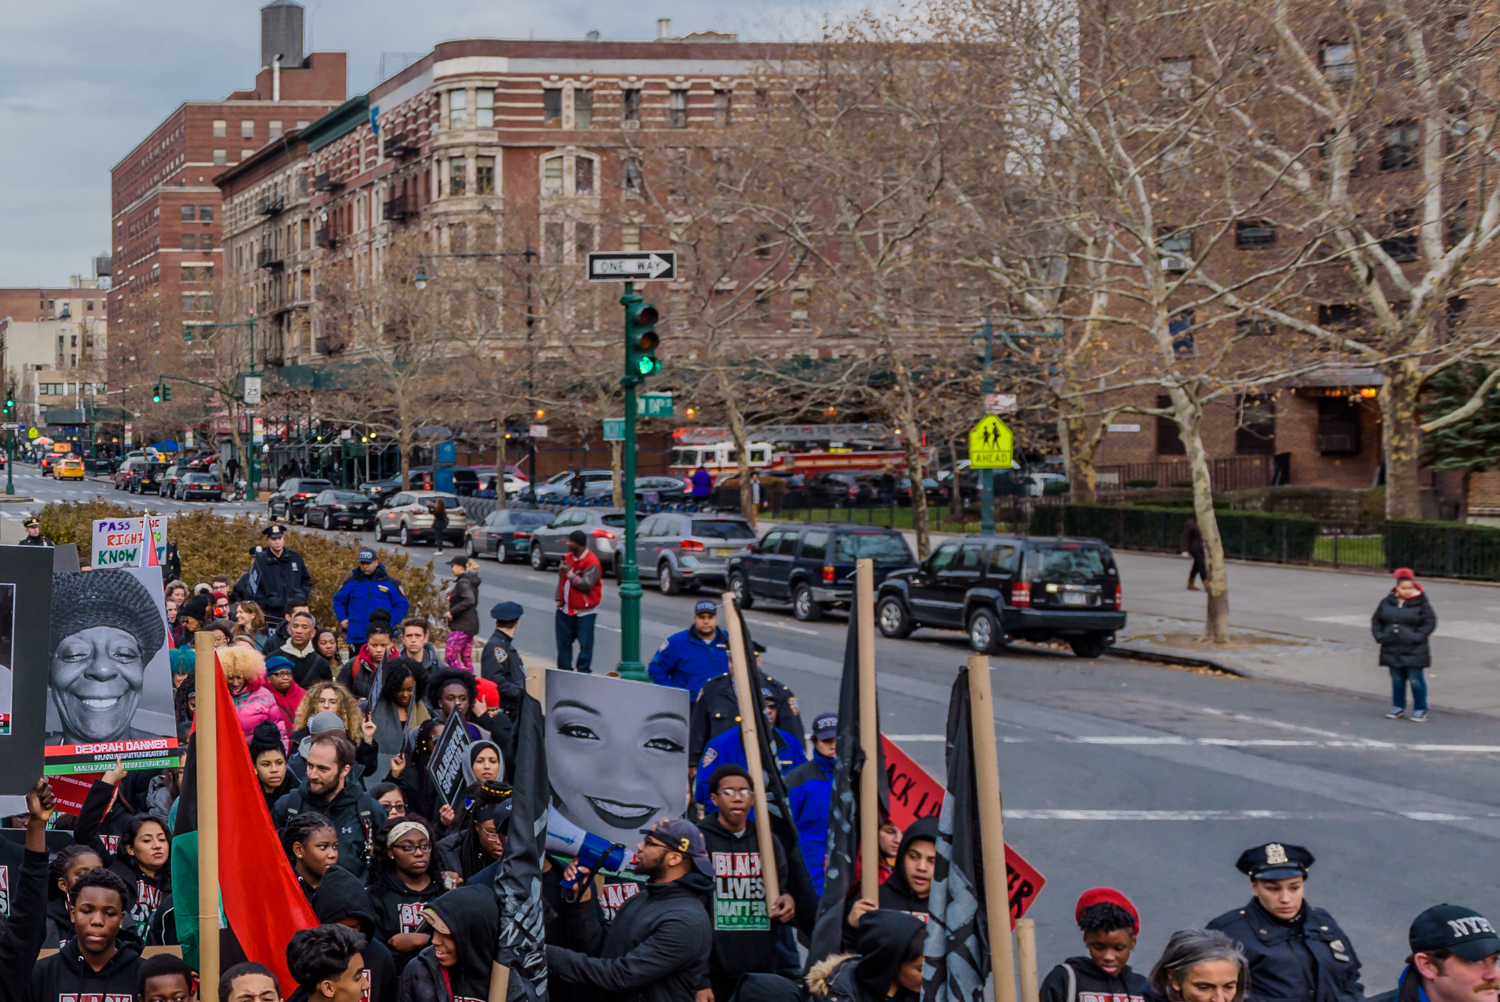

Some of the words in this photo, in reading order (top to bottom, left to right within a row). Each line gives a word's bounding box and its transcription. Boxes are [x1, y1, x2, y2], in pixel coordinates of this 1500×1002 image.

[600, 261, 625, 273] ONE
[636, 260, 662, 272] WAY
[247, 387, 259, 396] 25
[975, 453, 1008, 464] AHEAD
[98, 521, 132, 533] PASS
[97, 548, 138, 565] KNOW
[75, 742, 124, 755] DEBORAH
[125, 739, 168, 751] DANNER
[436, 724, 465, 786] ALBERTA
[886, 762, 917, 808] ACK
[601, 884, 637, 909] ACK
[715, 877, 766, 900] LIVES
[717, 901, 768, 916] MATTER
